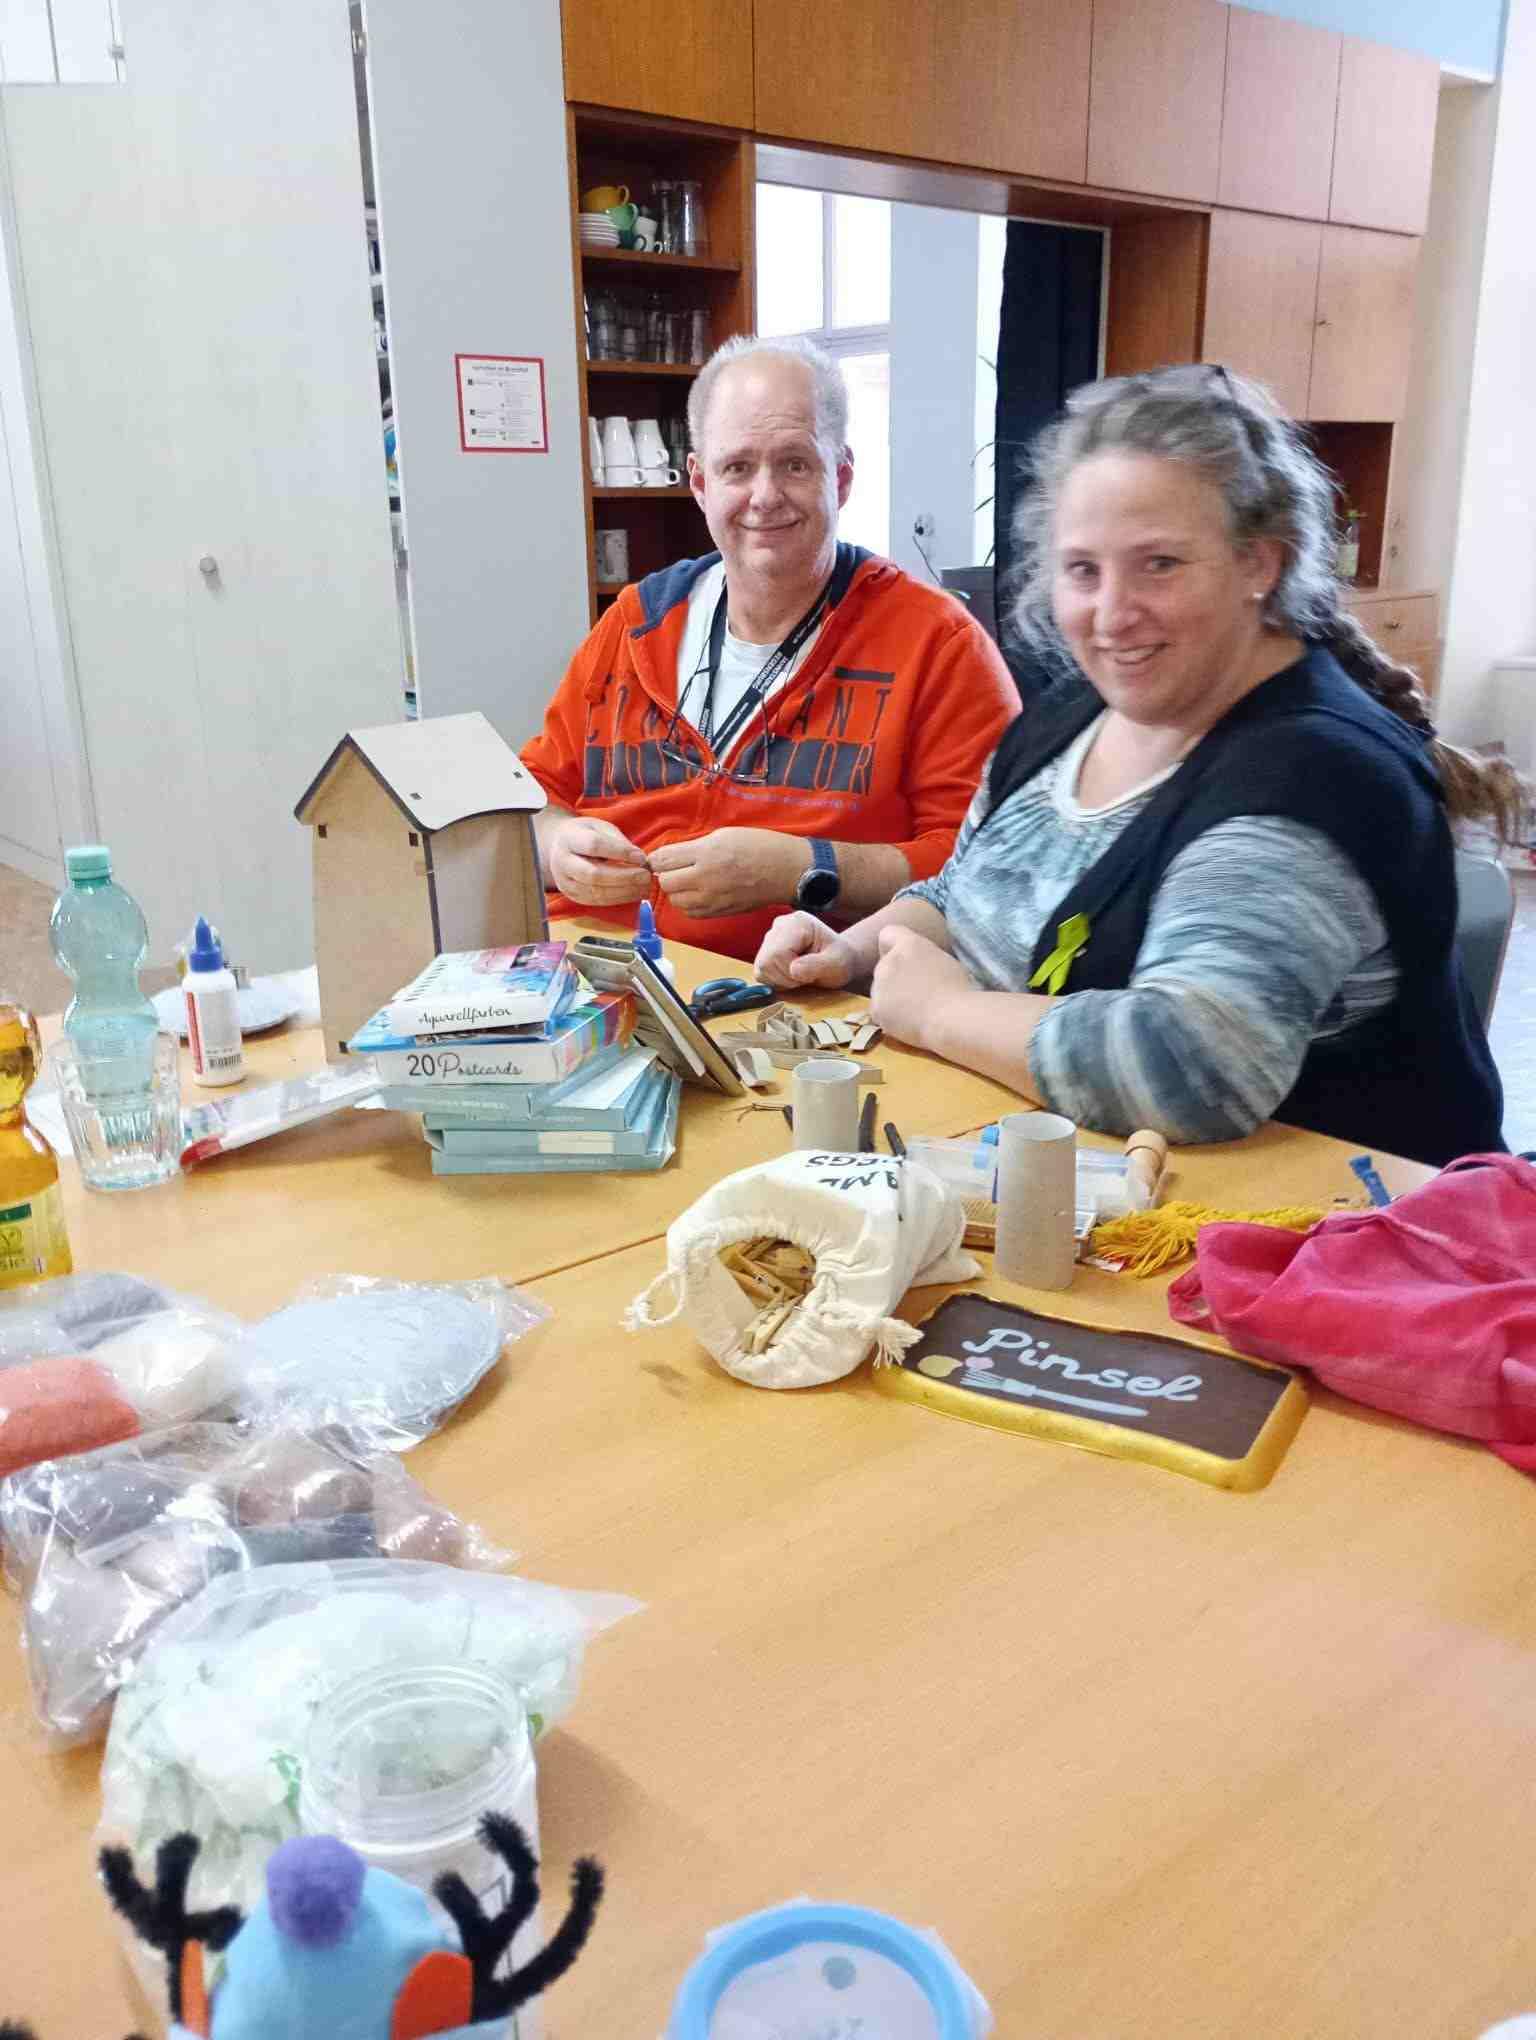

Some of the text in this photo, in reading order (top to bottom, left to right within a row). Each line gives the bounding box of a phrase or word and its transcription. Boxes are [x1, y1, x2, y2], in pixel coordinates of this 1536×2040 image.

[418, 1005, 513, 1029] Aquarellfarben
[407, 1052, 523, 1077] 20 Postcards
[962, 1328, 1204, 1401] Pinsel
